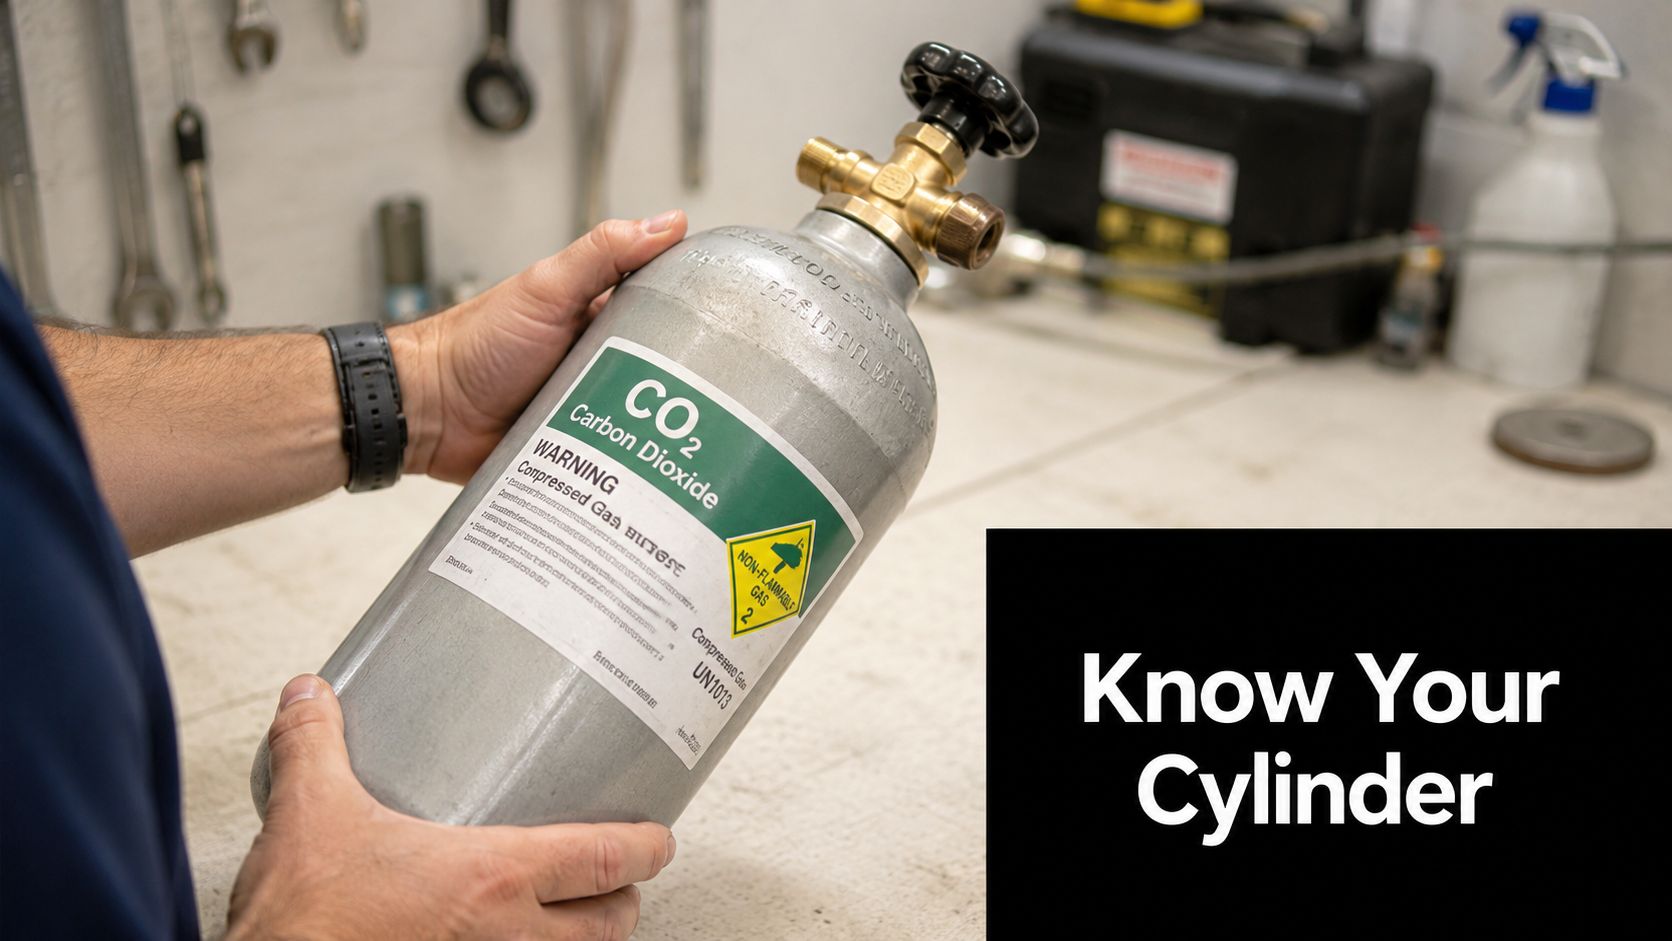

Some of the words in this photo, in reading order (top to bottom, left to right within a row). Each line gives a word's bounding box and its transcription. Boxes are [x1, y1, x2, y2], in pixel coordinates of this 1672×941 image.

[533, 439, 619, 495] WARNING
[570, 404, 637, 451] Carbon
[636, 440, 719, 509] Dioxide
[741, 607, 754, 624] 2
[750, 585, 769, 607] GAS
[692, 661, 732, 710] UN1013
